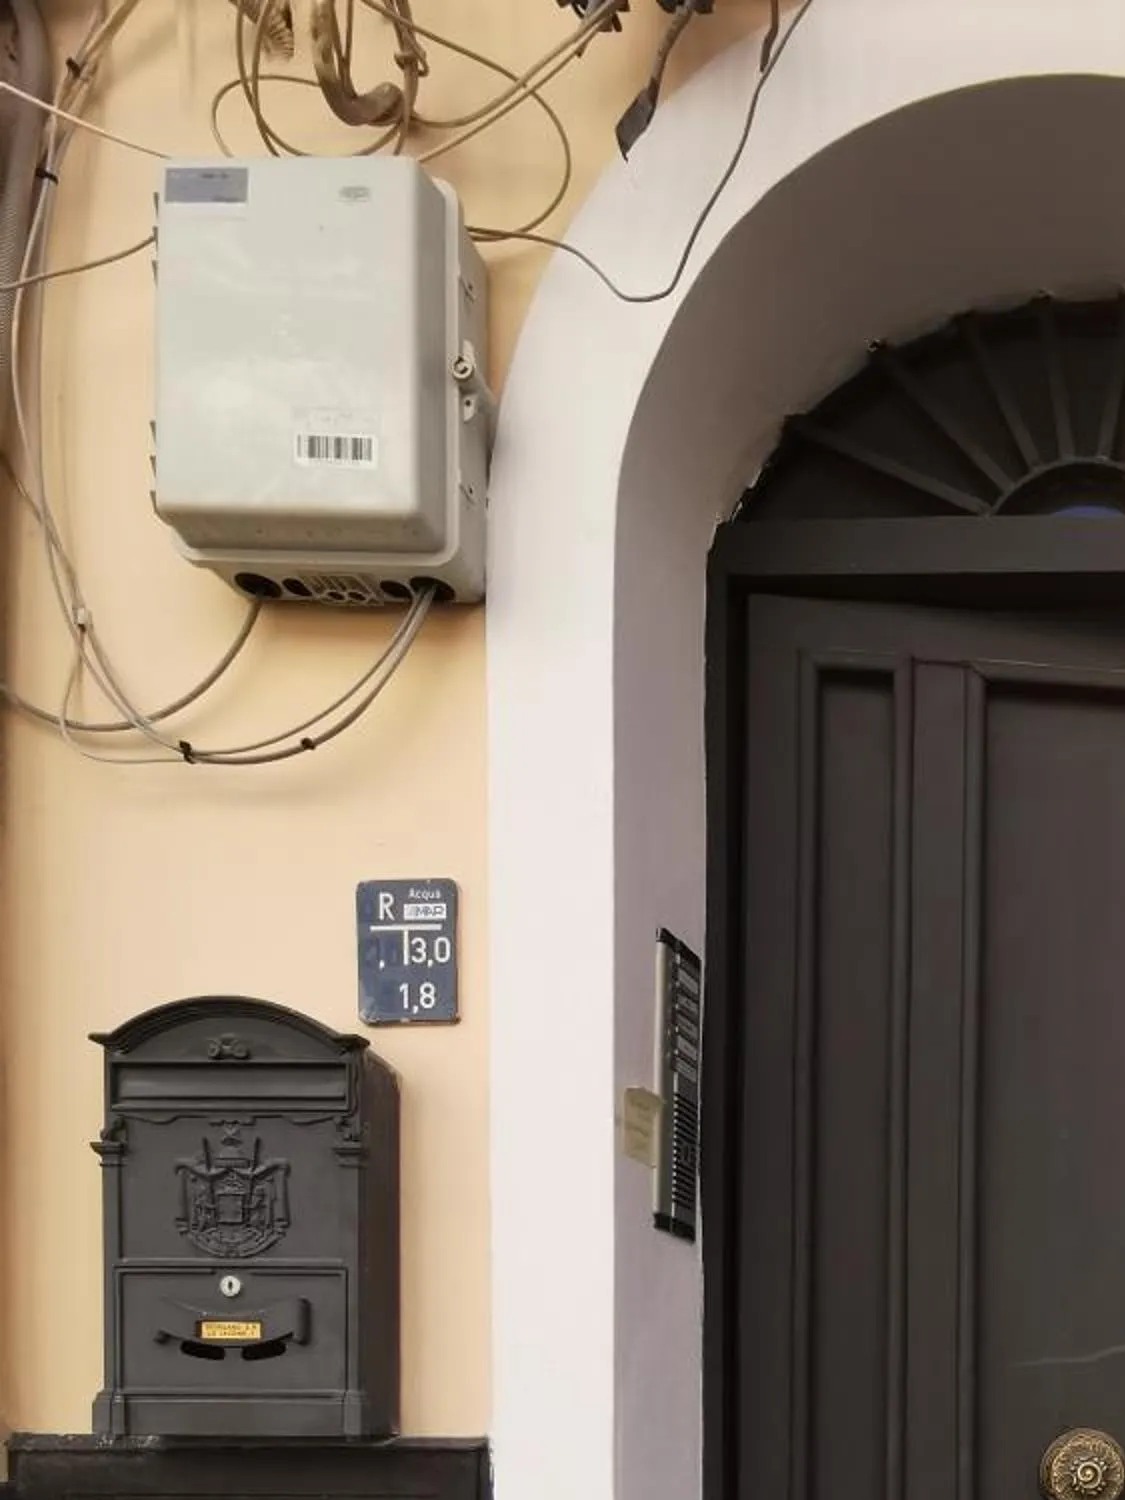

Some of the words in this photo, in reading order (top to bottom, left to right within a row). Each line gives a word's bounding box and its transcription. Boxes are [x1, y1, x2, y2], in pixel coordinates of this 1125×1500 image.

[378, 892, 395, 921] R
[411, 936, 450, 968] 3,0
[399, 981, 436, 1014] 1,8
